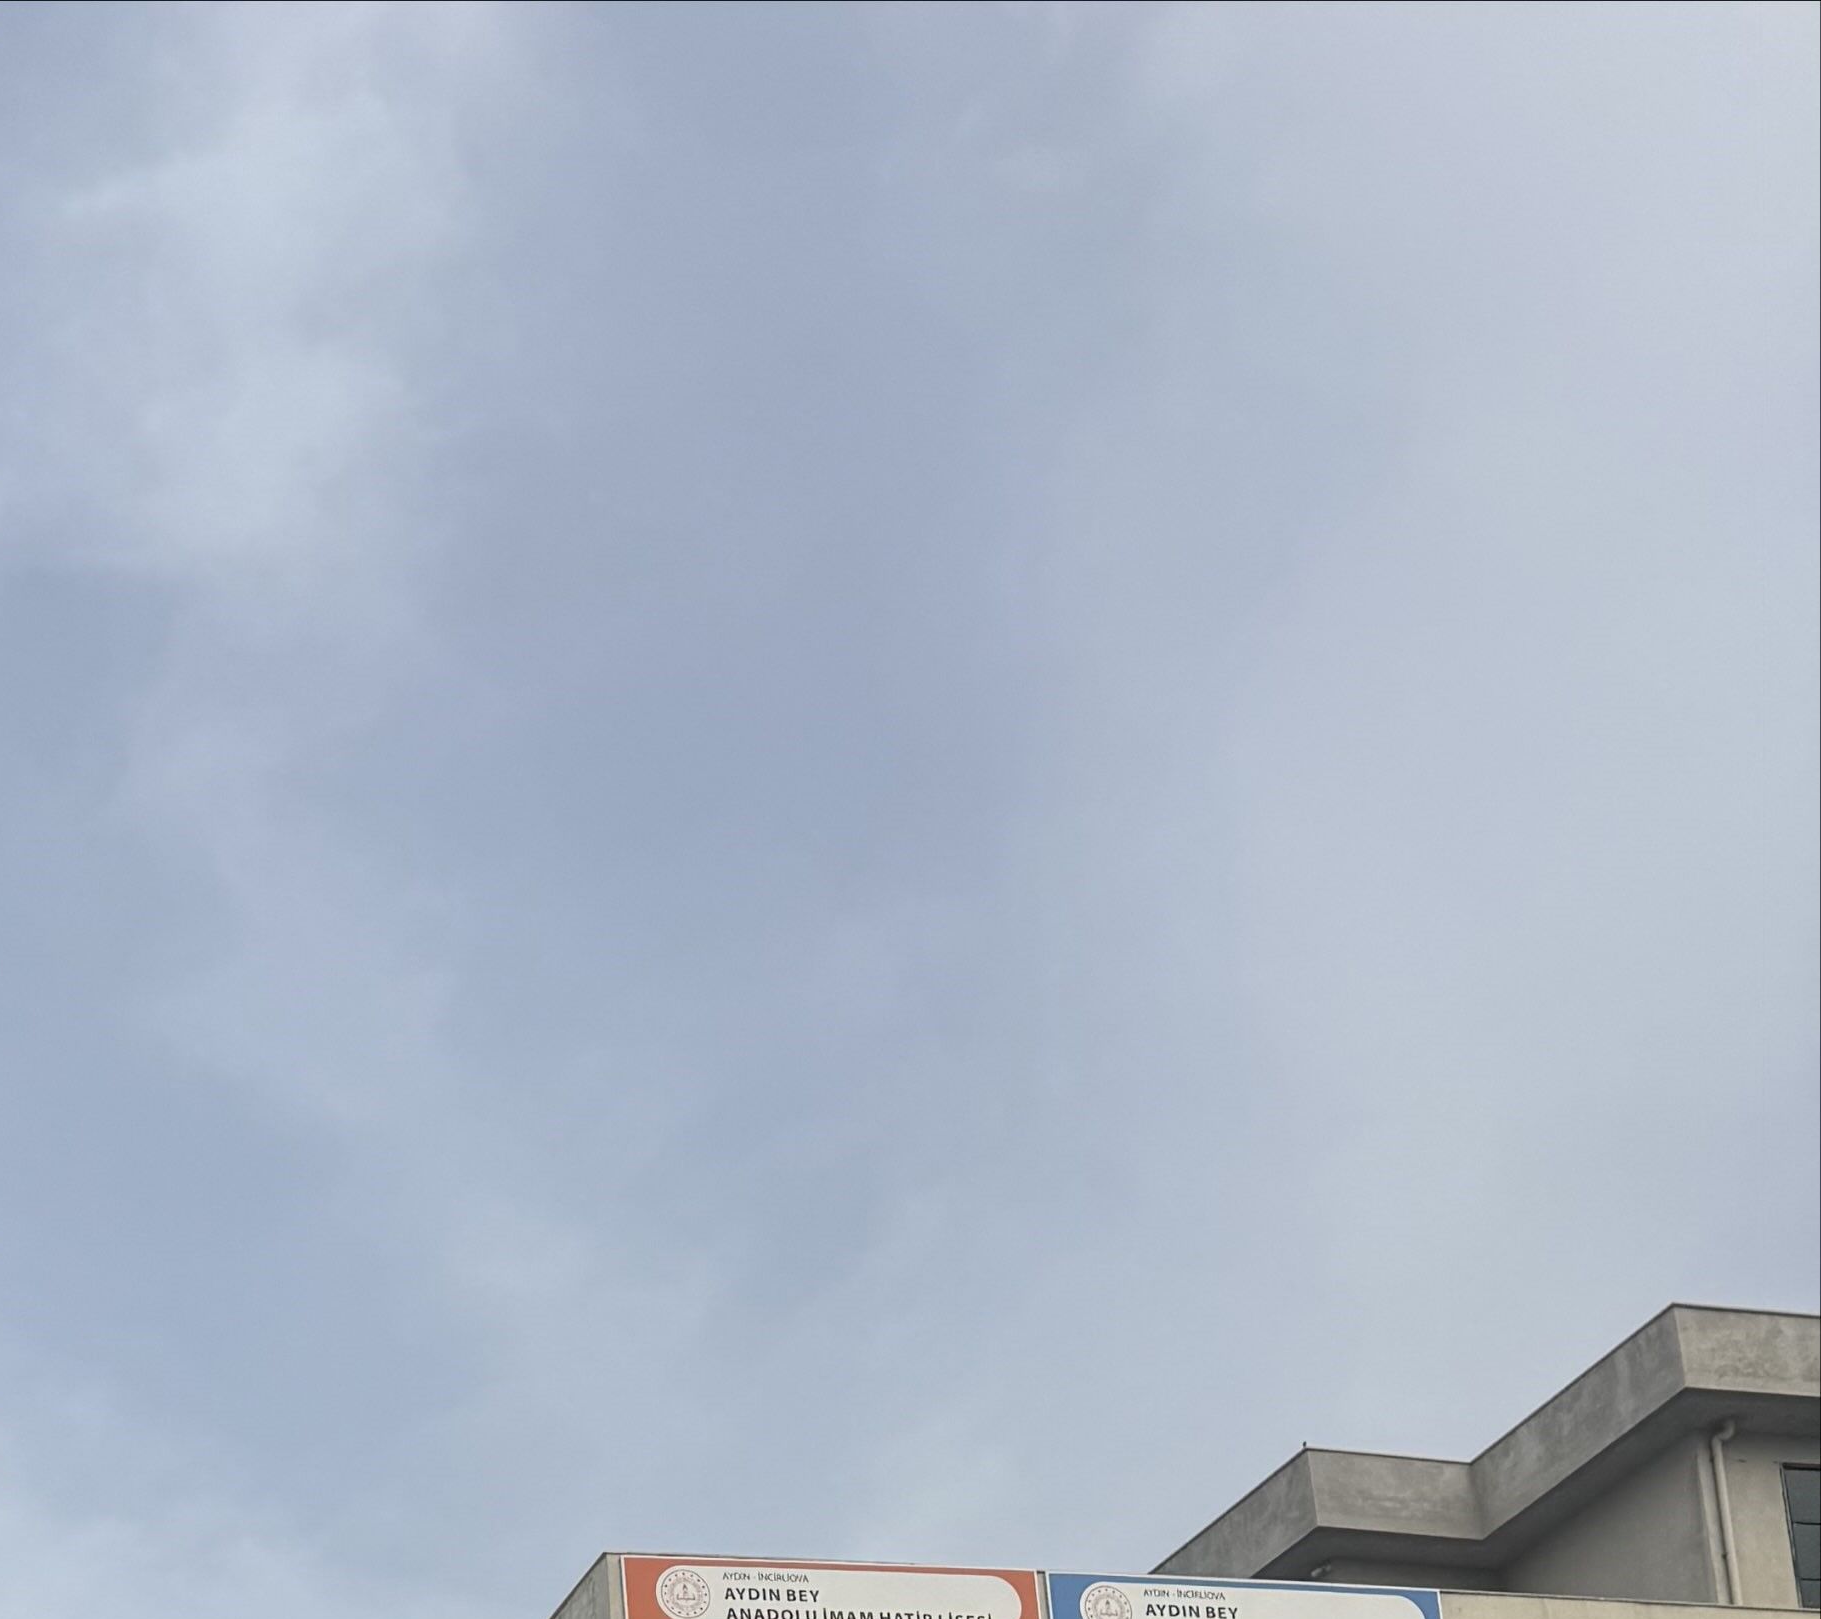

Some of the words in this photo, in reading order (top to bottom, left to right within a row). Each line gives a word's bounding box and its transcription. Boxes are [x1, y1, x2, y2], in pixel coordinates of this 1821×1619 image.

[724, 1587, 781, 1602] AYDIN
[786, 1589, 820, 1603] BEY
[1145, 1603, 1201, 1618] AYDIN
[1205, 1606, 1238, 1619] BEY
